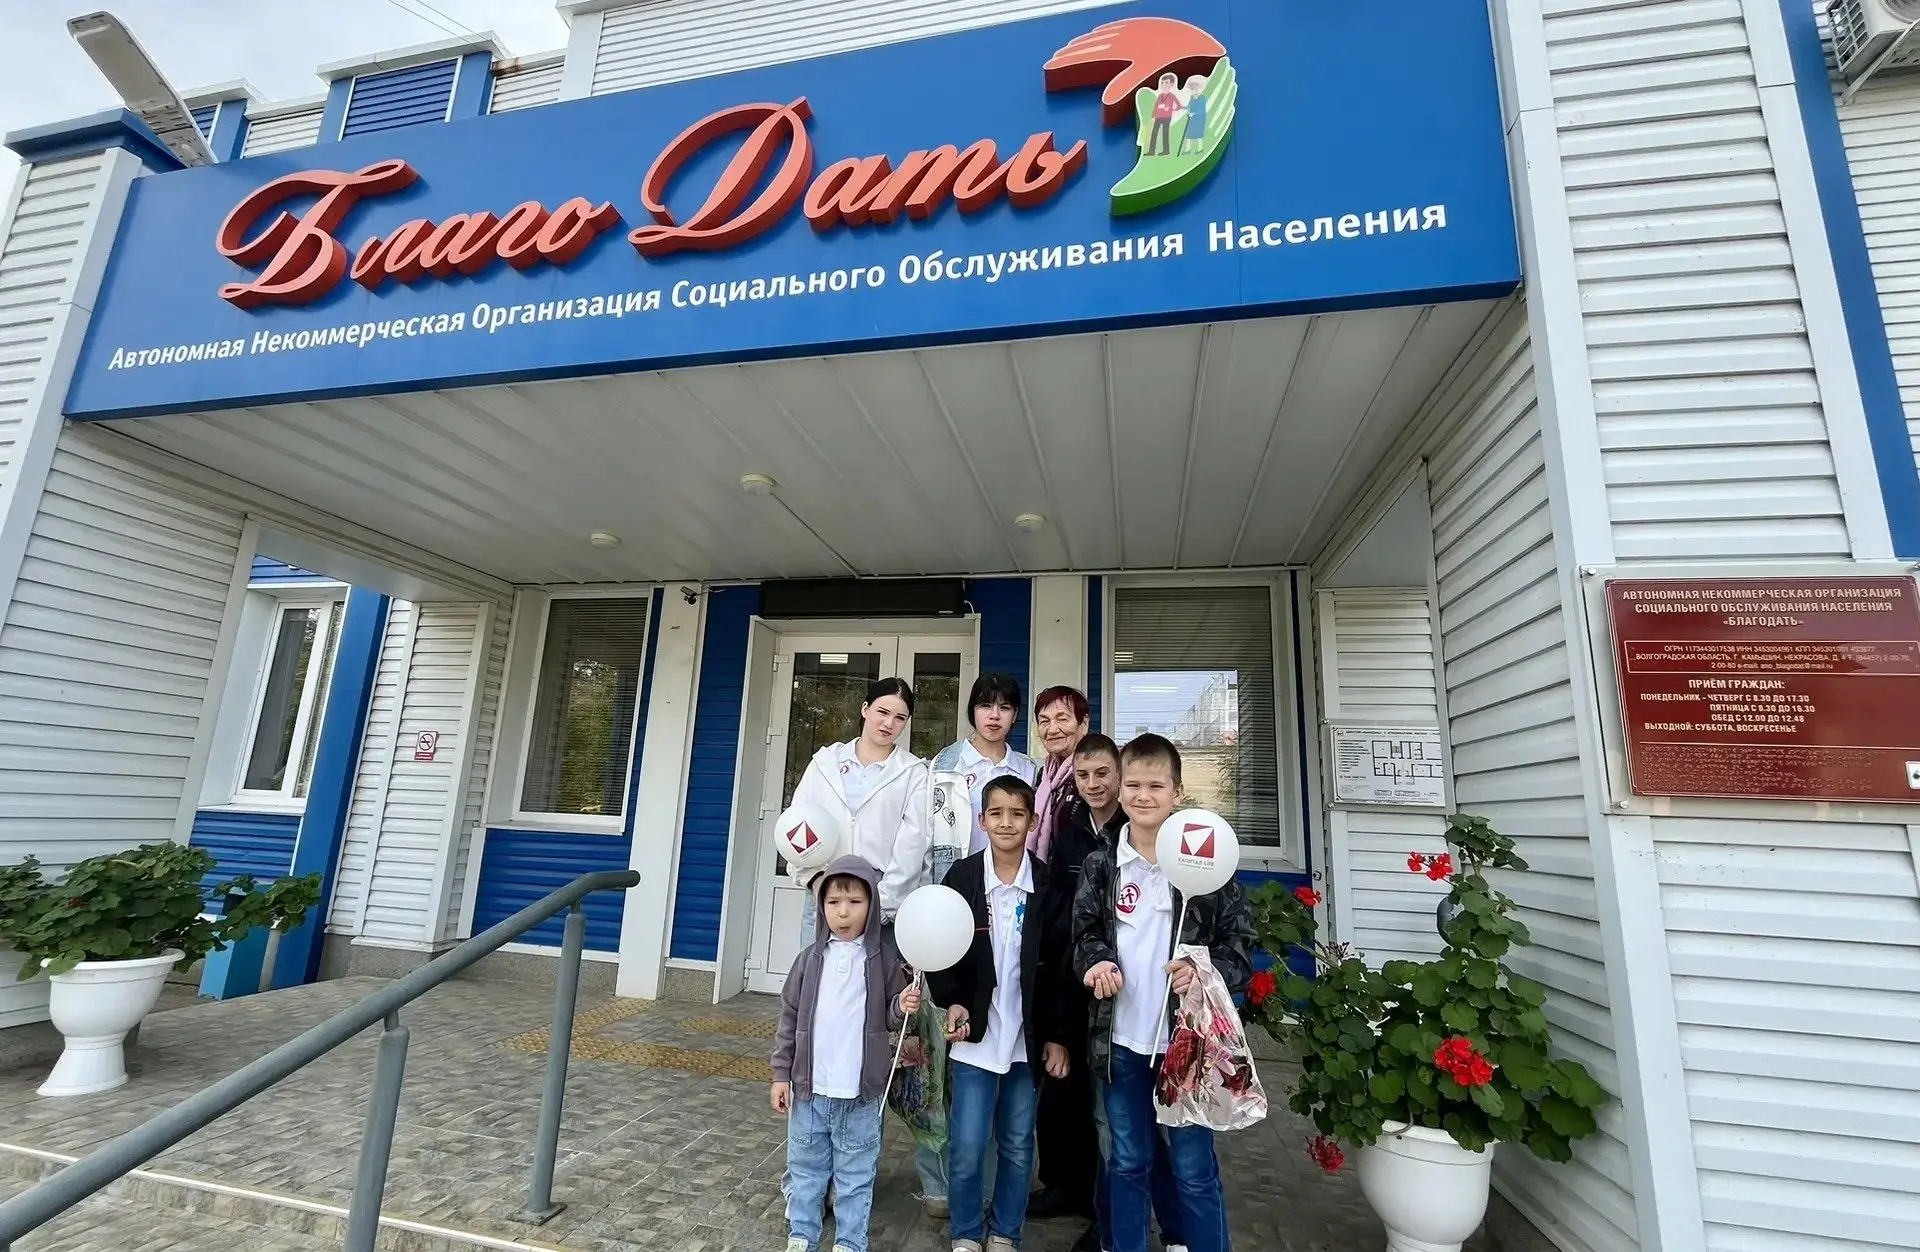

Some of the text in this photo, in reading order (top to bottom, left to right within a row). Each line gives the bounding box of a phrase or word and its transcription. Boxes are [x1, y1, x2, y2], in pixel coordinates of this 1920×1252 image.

[216, 95, 1088, 311] Благо Дать
[107, 203, 1449, 371] Автономная Некоммерческая Организация Социального Обслуживания Населения
[1622, 588, 1902, 600] АВТОНОМНАЯ НЕКОММЕРЧЕСКАЯ ОРГАНИЗАЦИЯ
[1635, 601, 1893, 614] СОЦИАЛЬНОГО ОБСЛУЖИВАНИЯ НАСЕЛЕНИЯ
[1636, 653, 1696, 661] ВОЛГОГРАДСКАЯ
[1728, 679, 1786, 690] ГРАЖДАН:
[1640, 692, 1701, 702] ПОНЕДЕЛЬНИК
[1707, 694, 1744, 702] ЧЕТВЕРГ
[1745, 694, 1752, 702] С
[1772, 694, 1785, 702] ДО
[1709, 703, 1750, 713] ПЯТНИЦА
[1751, 704, 1758, 712] С
[1778, 704, 1791, 713] ДО
[1711, 713, 1734, 722] ОБЕД
[1735, 713, 1742, 722] С
[1767, 714, 1780, 722] ДО
[1644, 721, 1694, 732] ВЫХОДНОЙ:
[1736, 723, 1797, 733] ВОСКРЕСЕНЬЕ
